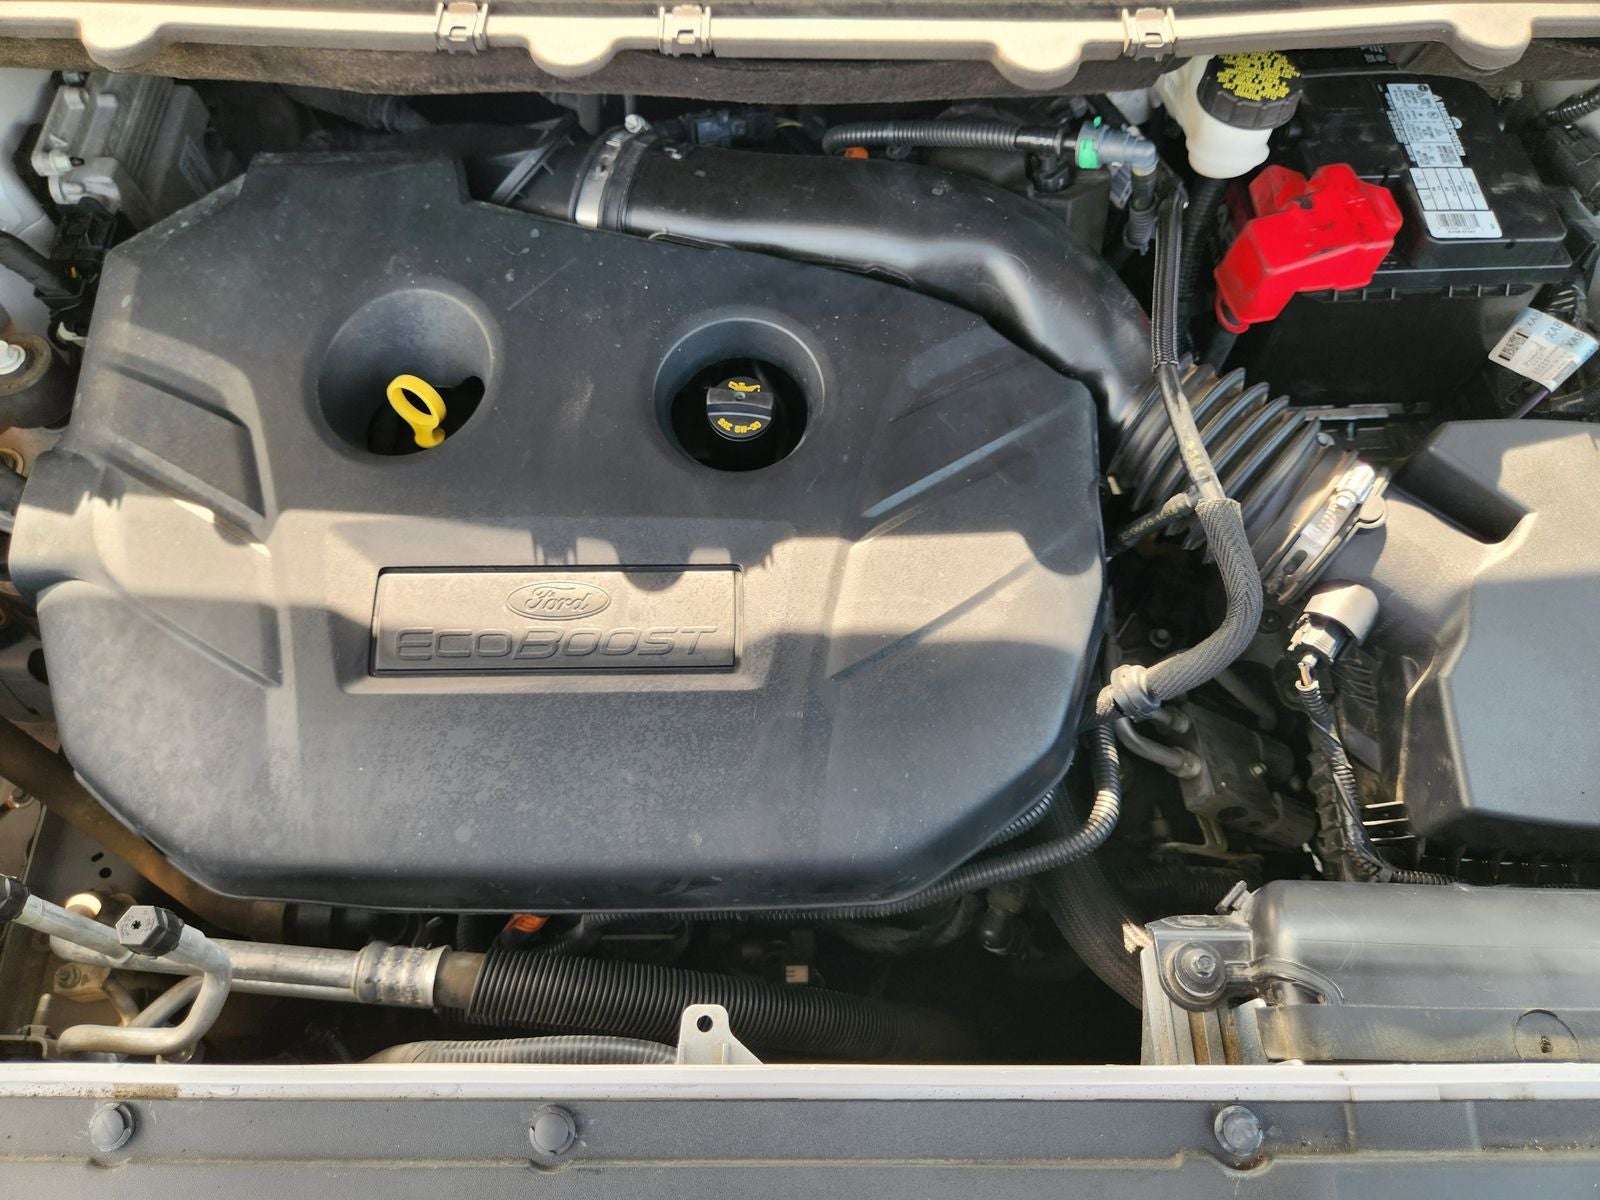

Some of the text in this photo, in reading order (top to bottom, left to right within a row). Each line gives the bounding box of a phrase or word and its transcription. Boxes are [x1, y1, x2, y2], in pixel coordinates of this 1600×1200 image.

[1545, 320, 1564, 339] XAB
[524, 586, 592, 612] Ford
[396, 625, 718, 661] ECOBOOST
